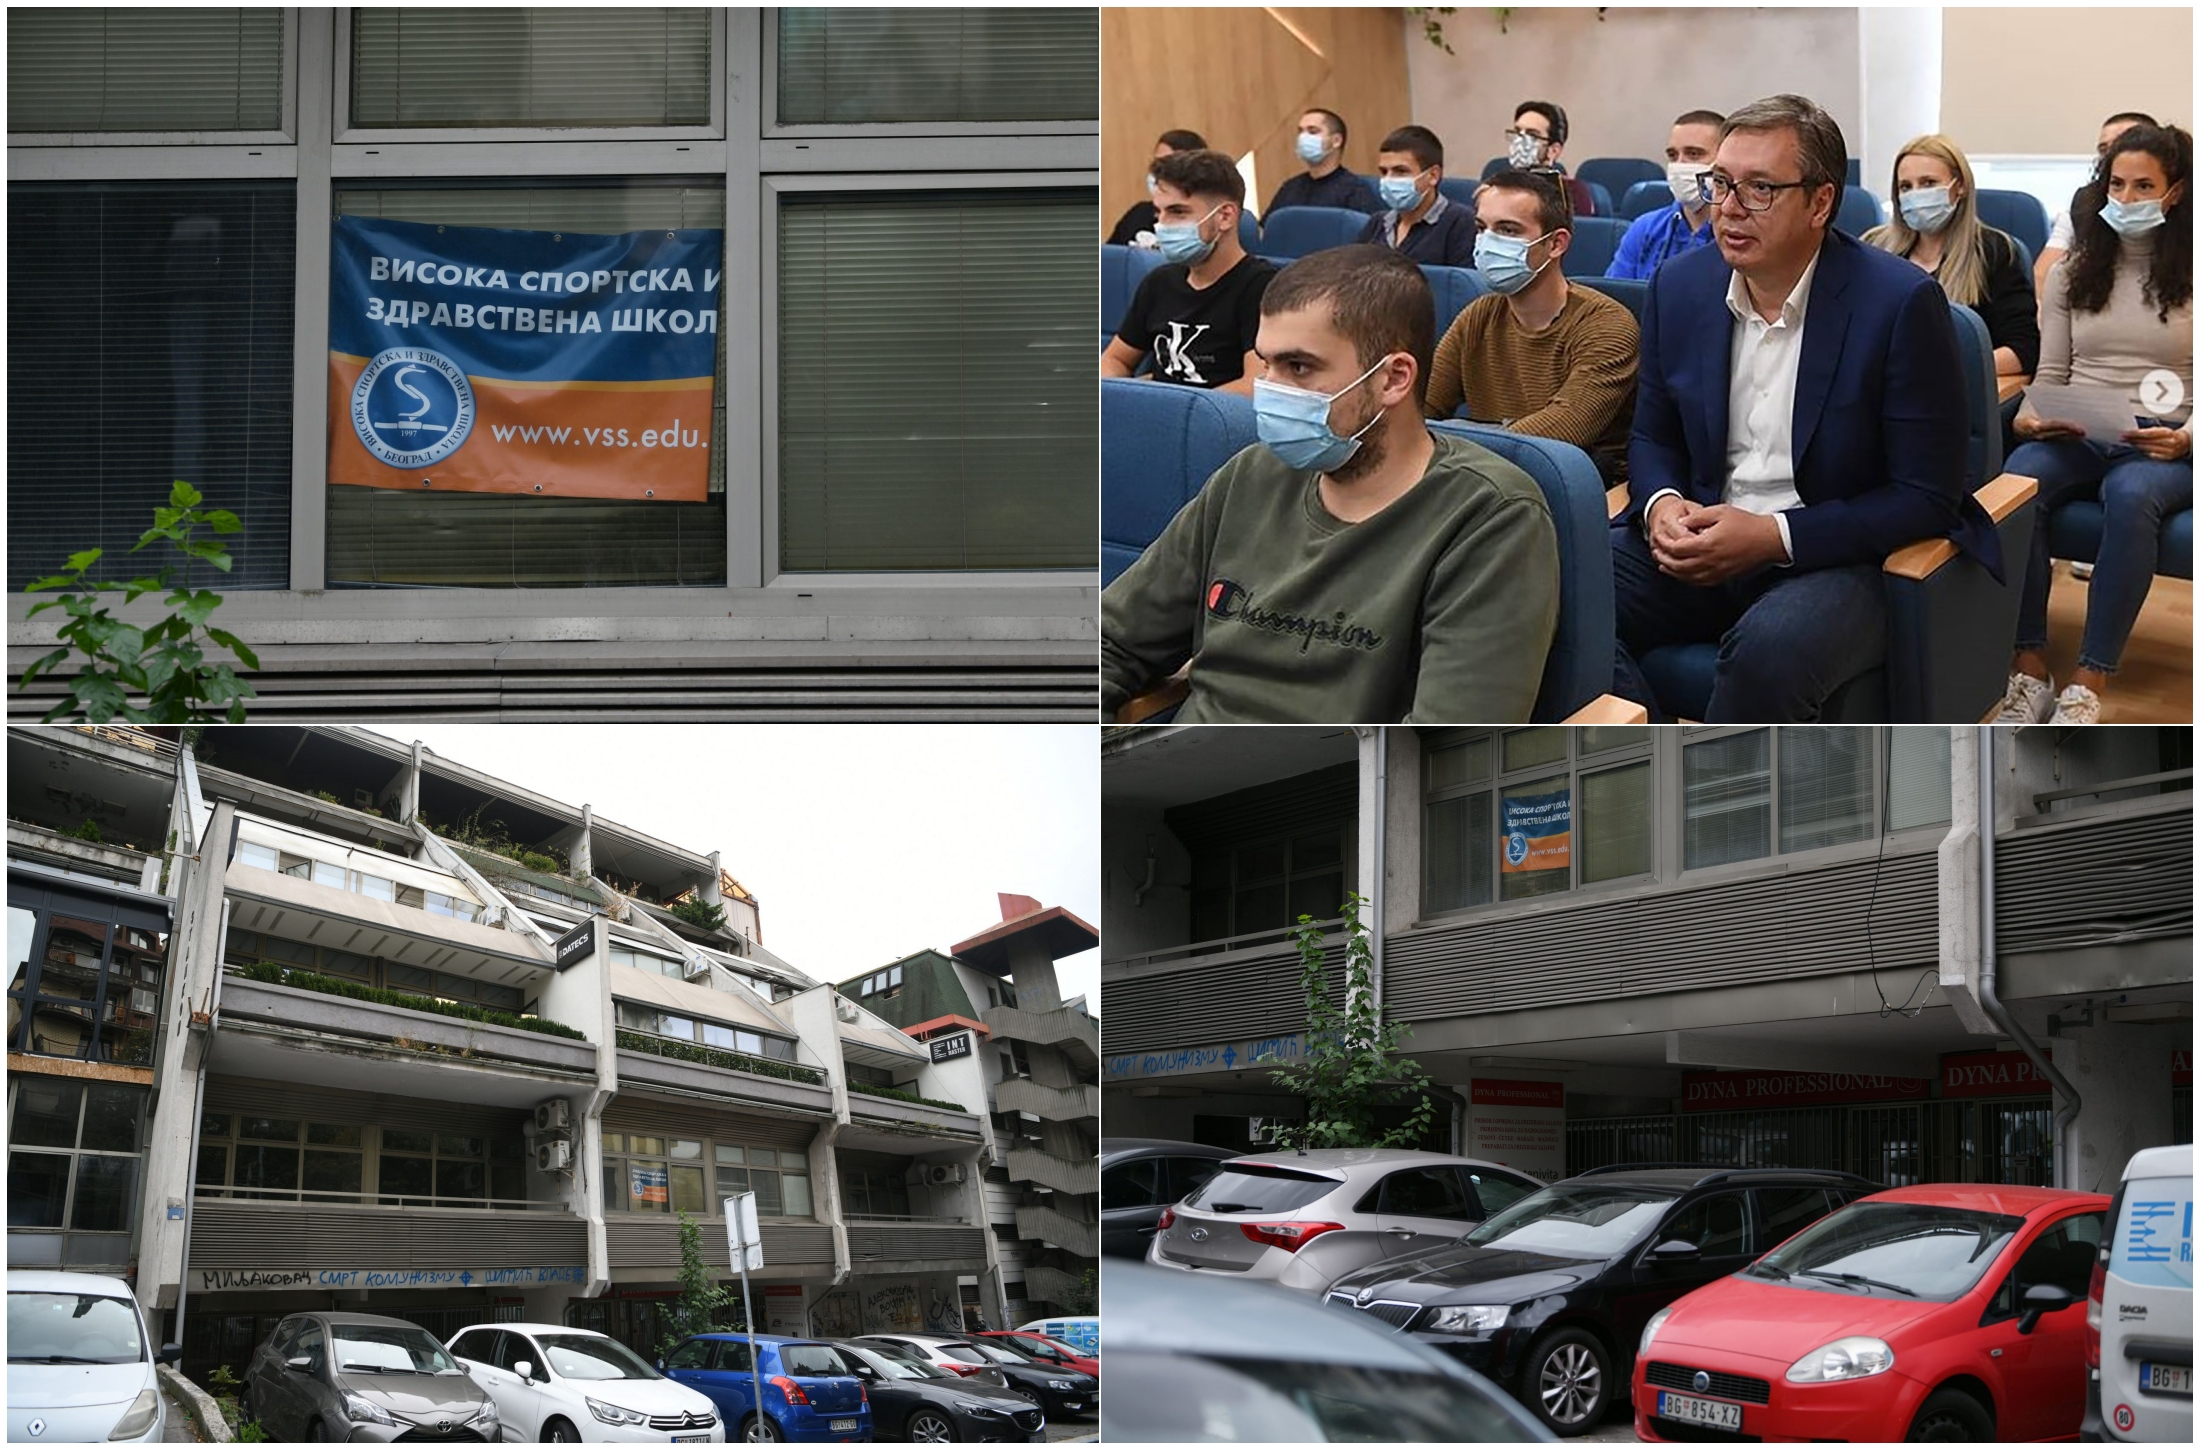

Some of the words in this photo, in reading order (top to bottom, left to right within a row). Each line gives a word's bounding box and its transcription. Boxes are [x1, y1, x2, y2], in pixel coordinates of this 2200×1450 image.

[370, 255, 509, 289] ВИСОКА
[520, 268, 694, 293] СПОРТСКА
[365, 297, 602, 334] ЗДРАВСТВЕНА
[611, 309, 718, 334] ШКОЛ
[405, 350, 414, 360] И
[356, 350, 402, 398] СПОРТСКА
[417, 351, 470, 410] ЗДРАВСТВЕНА
[354, 401, 378, 447] ВИСОКА
[400, 429, 418, 437] 1997
[441, 412, 470, 450] ШКОЛА
[491, 418, 708, 449] www.vss.edu.
[383, 449, 434, 465] БЕОГРАД
[1207, 578, 1385, 656] Champion
[562, 932, 589, 957] DATECS
[946, 1036, 965, 1050] INT
[1110, 1054, 1138, 1076] СМРТ
[1142, 1048, 1219, 1074] КОМУНИЗМУ
[1688, 1079, 1738, 1101] DYNA
[1746, 1073, 1893, 1097] PROFESSIONAL
[1947, 1063, 2012, 1087] DYNA
[1474, 1088, 1495, 1096] DYNA
[1497, 1089, 1550, 1099] PROFESSIONAL
[318, 1270, 360, 1287] СМРТ
[365, 1270, 456, 1287] КОМУНИЗМУ
[2119, 1304, 2148, 1314] DACIA
[2153, 1366, 2170, 1388] BG
[1667, 1396, 1681, 1414] BG
[2118, 1409, 2129, 1424] 80
